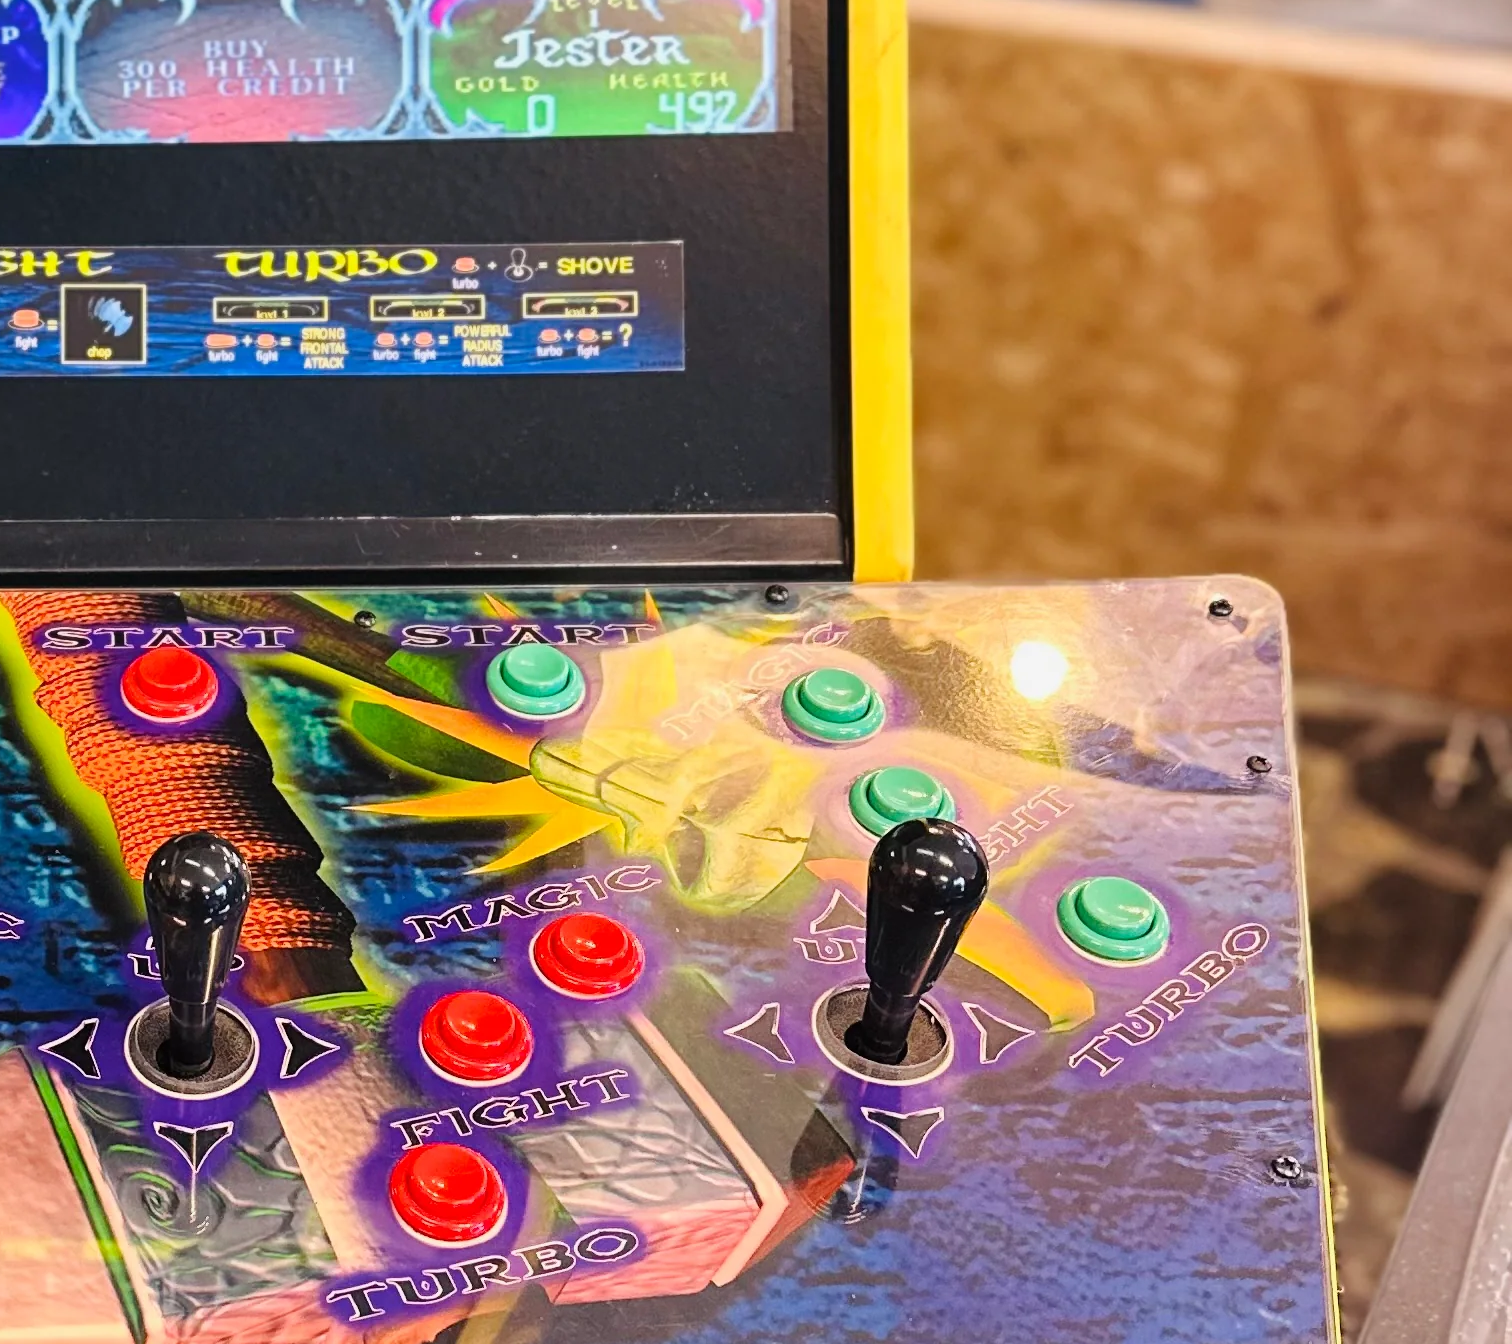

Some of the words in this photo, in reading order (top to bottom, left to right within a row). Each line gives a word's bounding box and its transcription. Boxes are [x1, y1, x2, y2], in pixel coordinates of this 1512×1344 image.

[203, 39, 268, 59] BUY
[205, 56, 356, 78] HEALTH
[122, 78, 187, 98] PER
[216, 76, 351, 97] CREDIT
[454, 74, 541, 93] GOLD
[608, 71, 730, 90] HEALTH
[213, 247, 439, 283] TURBO
[556, 256, 635, 275] SHOVE
[301, 327, 346, 341] STRONG
[619, 323, 634, 348] ?
[303, 357, 345, 370] ATTACK
[461, 354, 505, 368] ATTACK
[41, 625, 295, 649] START
[399, 622, 656, 646] START
[976, 784, 1075, 866] GHT
[403, 864, 663, 944] MAGIC
[1069, 922, 1270, 1078] TURBO
[390, 1068, 633, 1150] FIGHT
[327, 1227, 640, 1323] TURBO
